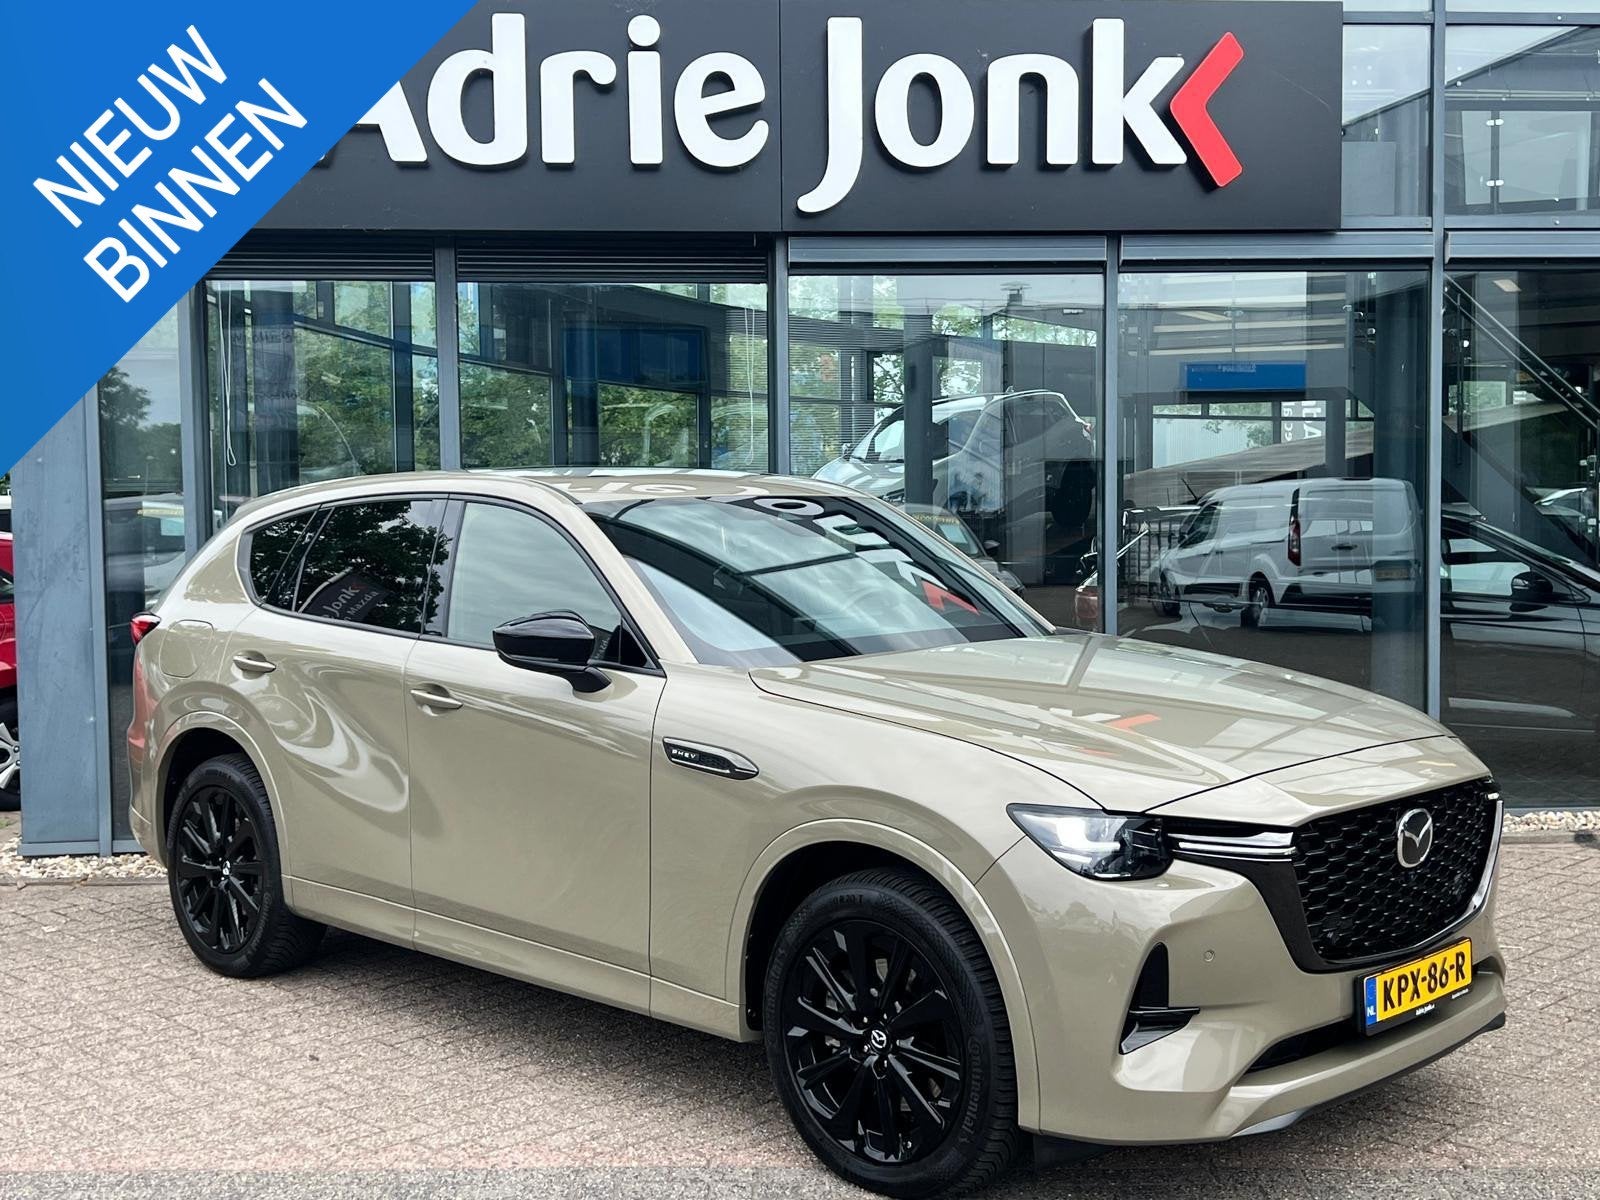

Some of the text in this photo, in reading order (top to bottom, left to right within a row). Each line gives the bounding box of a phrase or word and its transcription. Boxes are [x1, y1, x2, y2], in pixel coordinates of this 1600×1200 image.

[797, 17, 1187, 213] Jonk
[671, 748, 696, 759] PHEV
[1383, 951, 1466, 1012] KPX-86-R
[1366, 1005, 1377, 1017] NL
